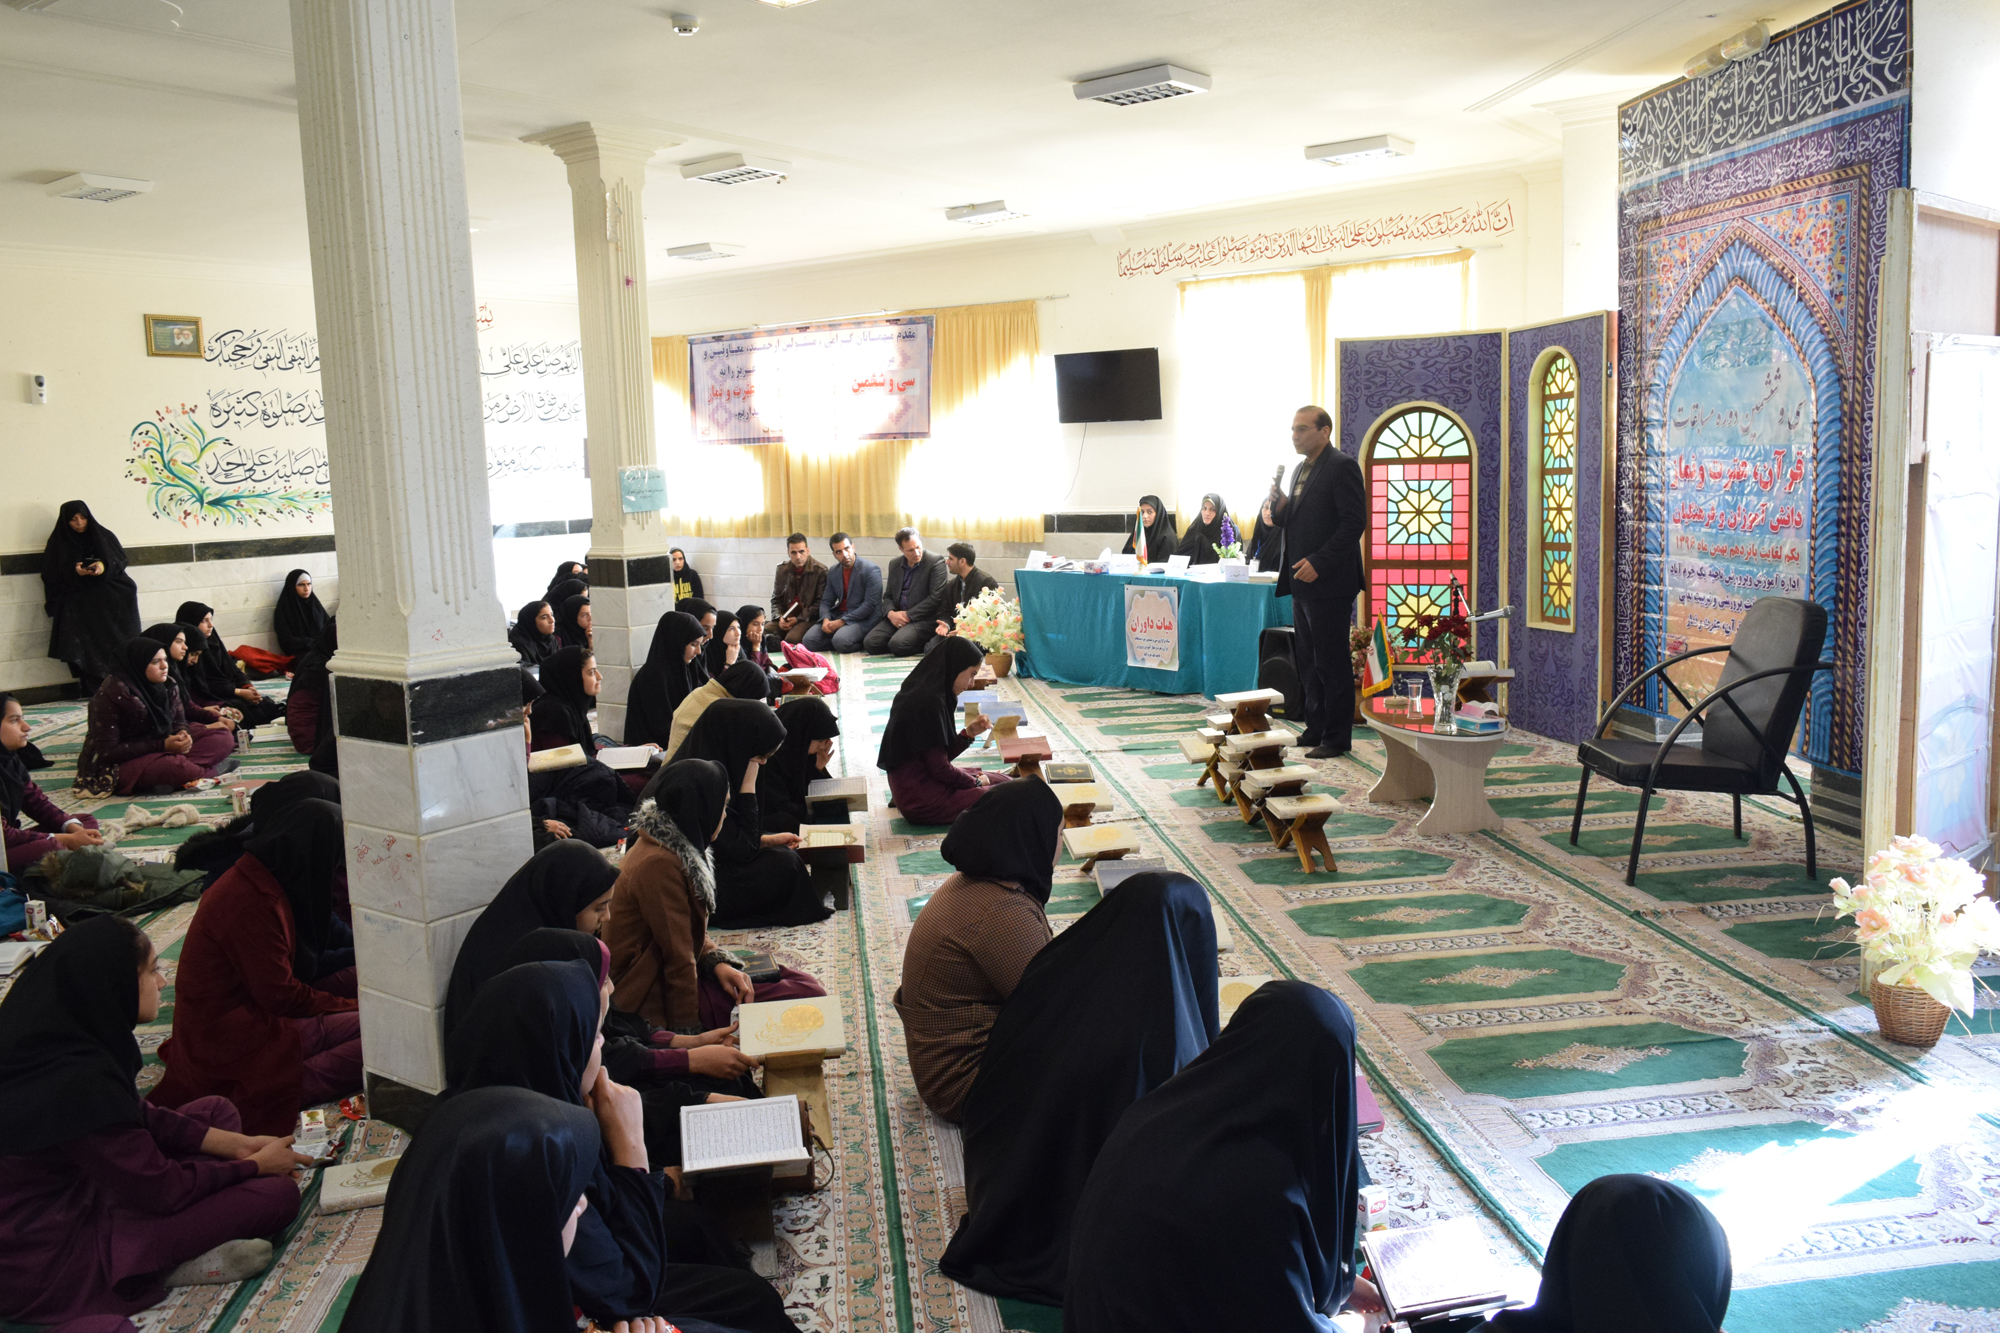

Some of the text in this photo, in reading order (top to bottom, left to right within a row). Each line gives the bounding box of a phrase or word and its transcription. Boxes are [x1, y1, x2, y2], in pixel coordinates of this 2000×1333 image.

[897, 328, 916, 343] مقدم
[703, 350, 708, 360] و
[851, 372, 916, 394] سی و ششمین
[708, 383, 755, 403] عترت و نماز
[1673, 402, 1714, 435] مسابقات
[1716, 409, 1738, 427] دوره
[1778, 406, 1785, 424] و
[1787, 398, 1807, 431] سی
[1709, 458, 1748, 491] عترت
[1672, 502, 1803, 533] دانش آموزان و فرهنگیان
[1697, 538, 1708, 552] ماه
[1709, 541, 1728, 558] بهمن
[1729, 542, 1757, 562] پانزدهم
[1759, 545, 1783, 563] لغایت
[1785, 547, 1800, 566] یکم
[1754, 572, 1780, 593] آموزش
[1780, 577, 1799, 594] اداره
[1131, 615, 1154, 633] داوران
